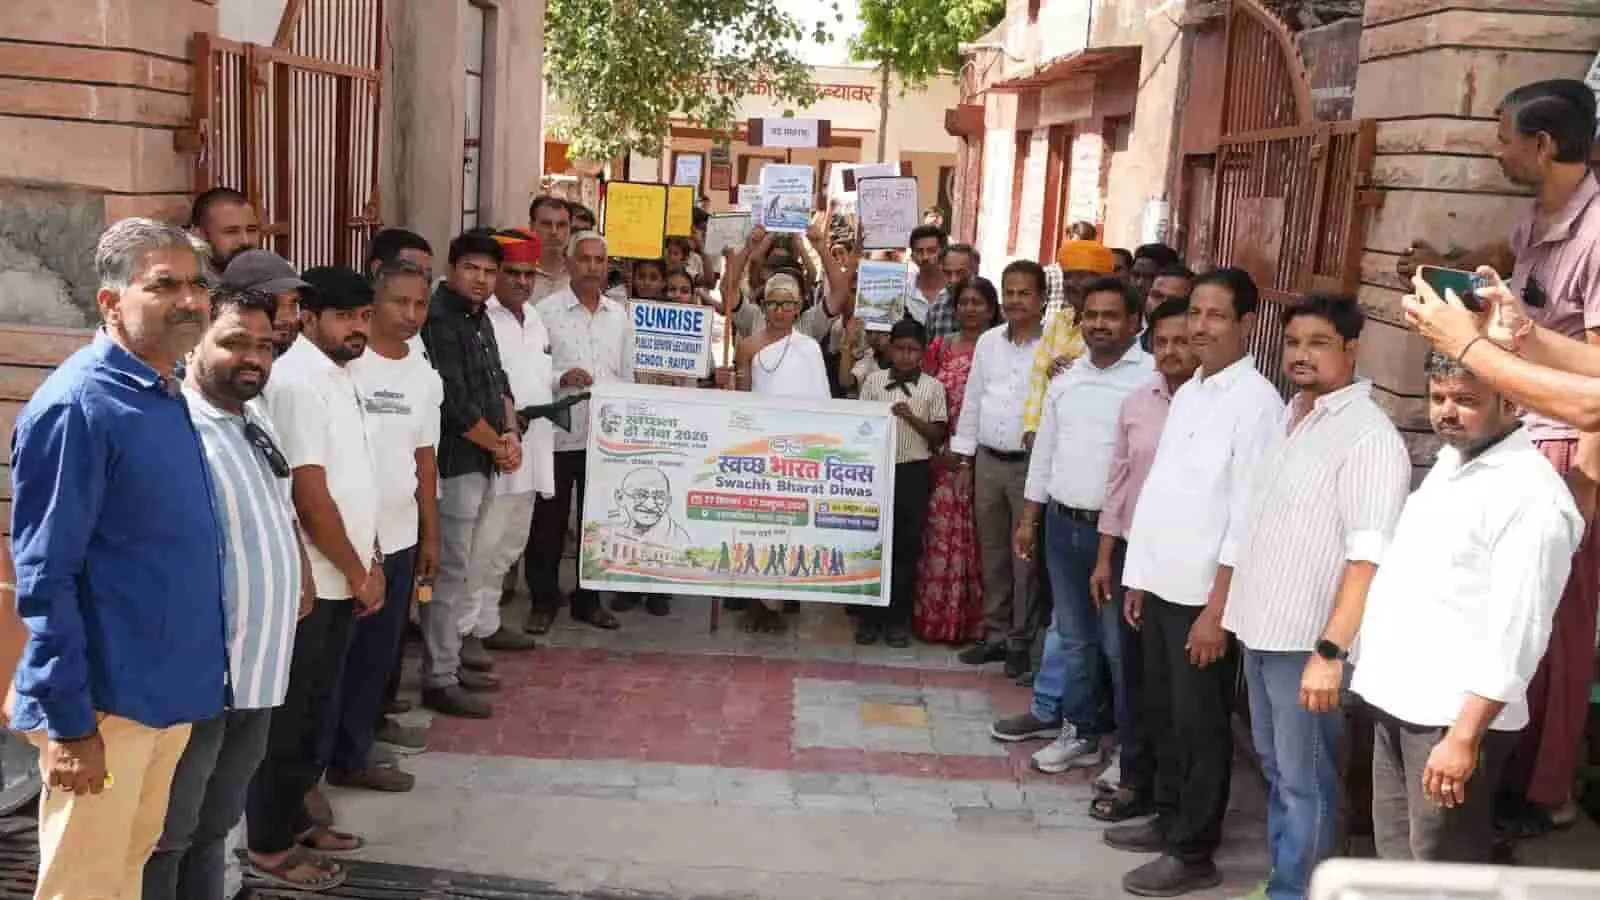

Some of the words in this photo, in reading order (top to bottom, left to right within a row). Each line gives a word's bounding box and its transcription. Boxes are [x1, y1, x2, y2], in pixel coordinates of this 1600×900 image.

[635, 305, 704, 332] SUNRISE
[635, 353, 663, 367] SCHOOL
[668, 356, 696, 370] RAIPUR
[675, 430, 709, 442] 2026
[718, 456, 766, 475] स्वच्छ
[770, 455, 820, 480] भारत
[825, 456, 874, 482] दिवस
[715, 476, 771, 492] Swachh
[777, 480, 825, 495] Bharat
[830, 484, 873, 497] Diwas
